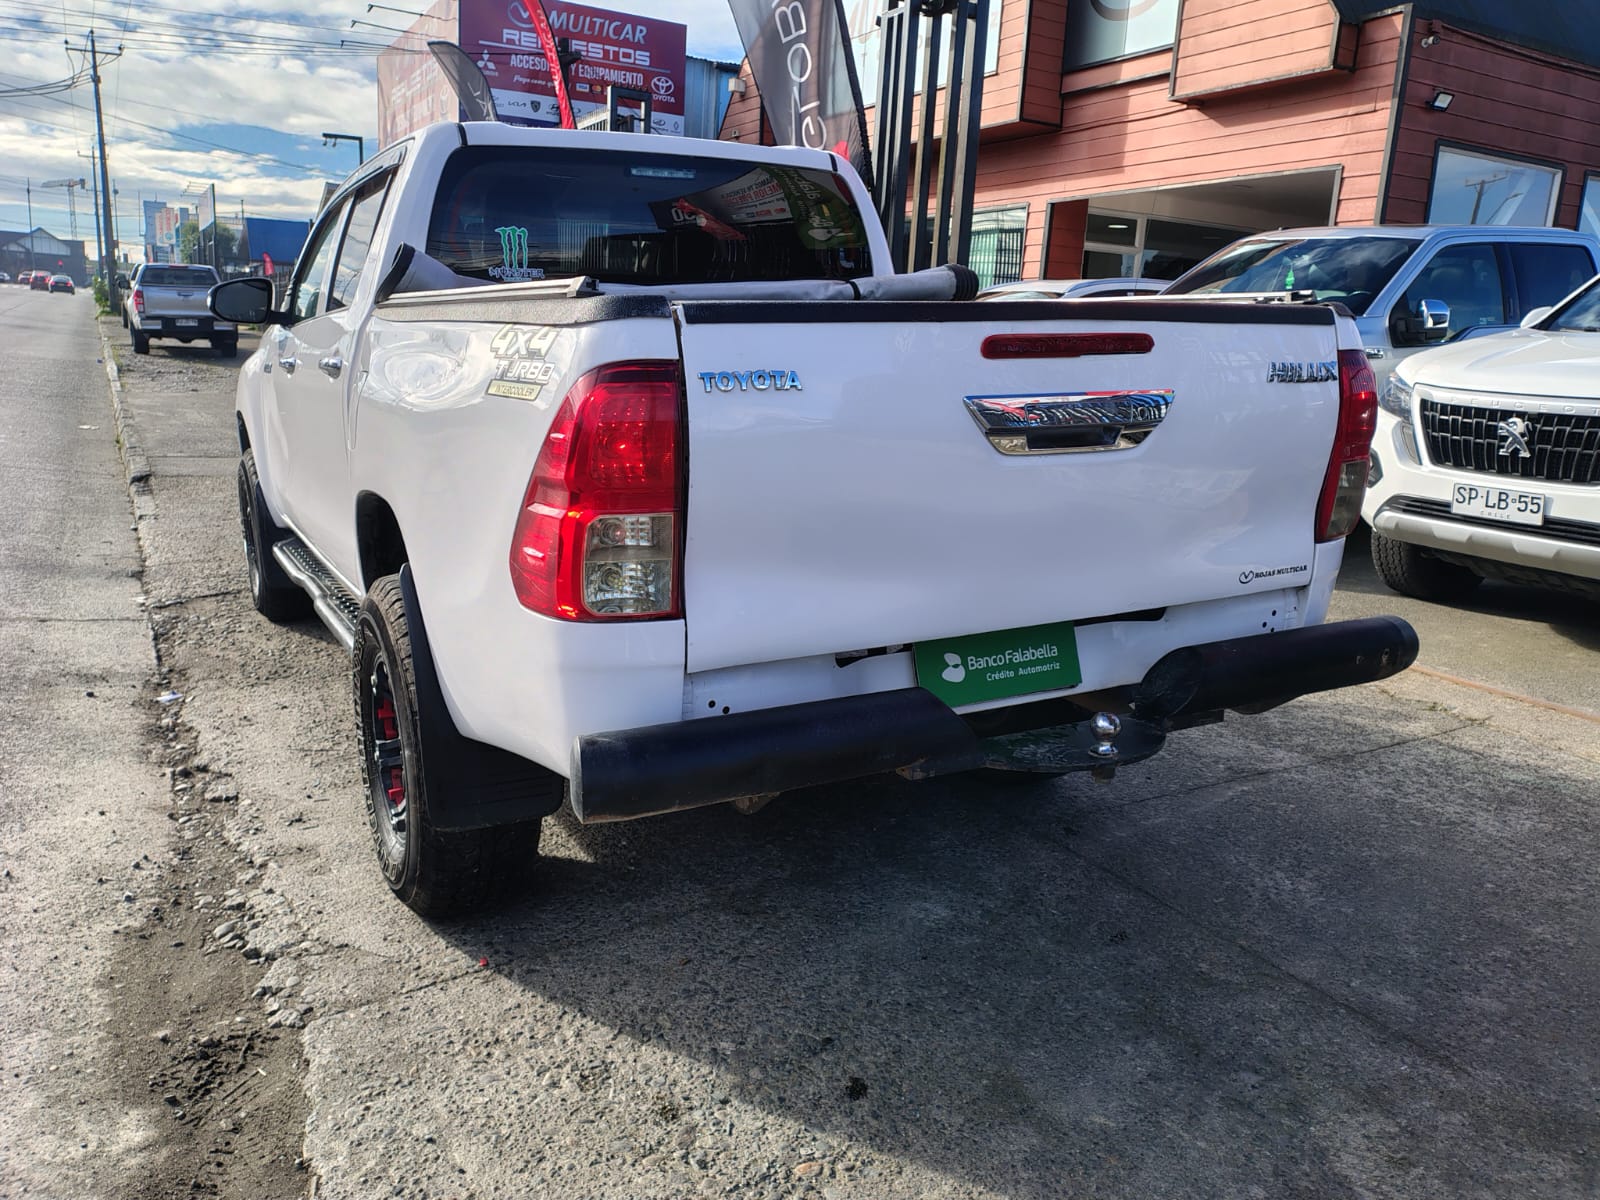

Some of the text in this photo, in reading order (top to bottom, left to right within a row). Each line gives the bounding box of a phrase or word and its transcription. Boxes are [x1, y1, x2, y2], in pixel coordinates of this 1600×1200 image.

[549, 10, 647, 44] MULTICAR
[571, 63, 576, 76] Y
[579, 63, 644, 86] EQUIPAMIENTO
[488, 266, 545, 279] MONSTER
[496, 360, 555, 384] TURBO
[698, 369, 802, 393] TOYOTA
[1267, 360, 1338, 383] HILUX
[986, 661, 1060, 681] Crédito Automotriz
